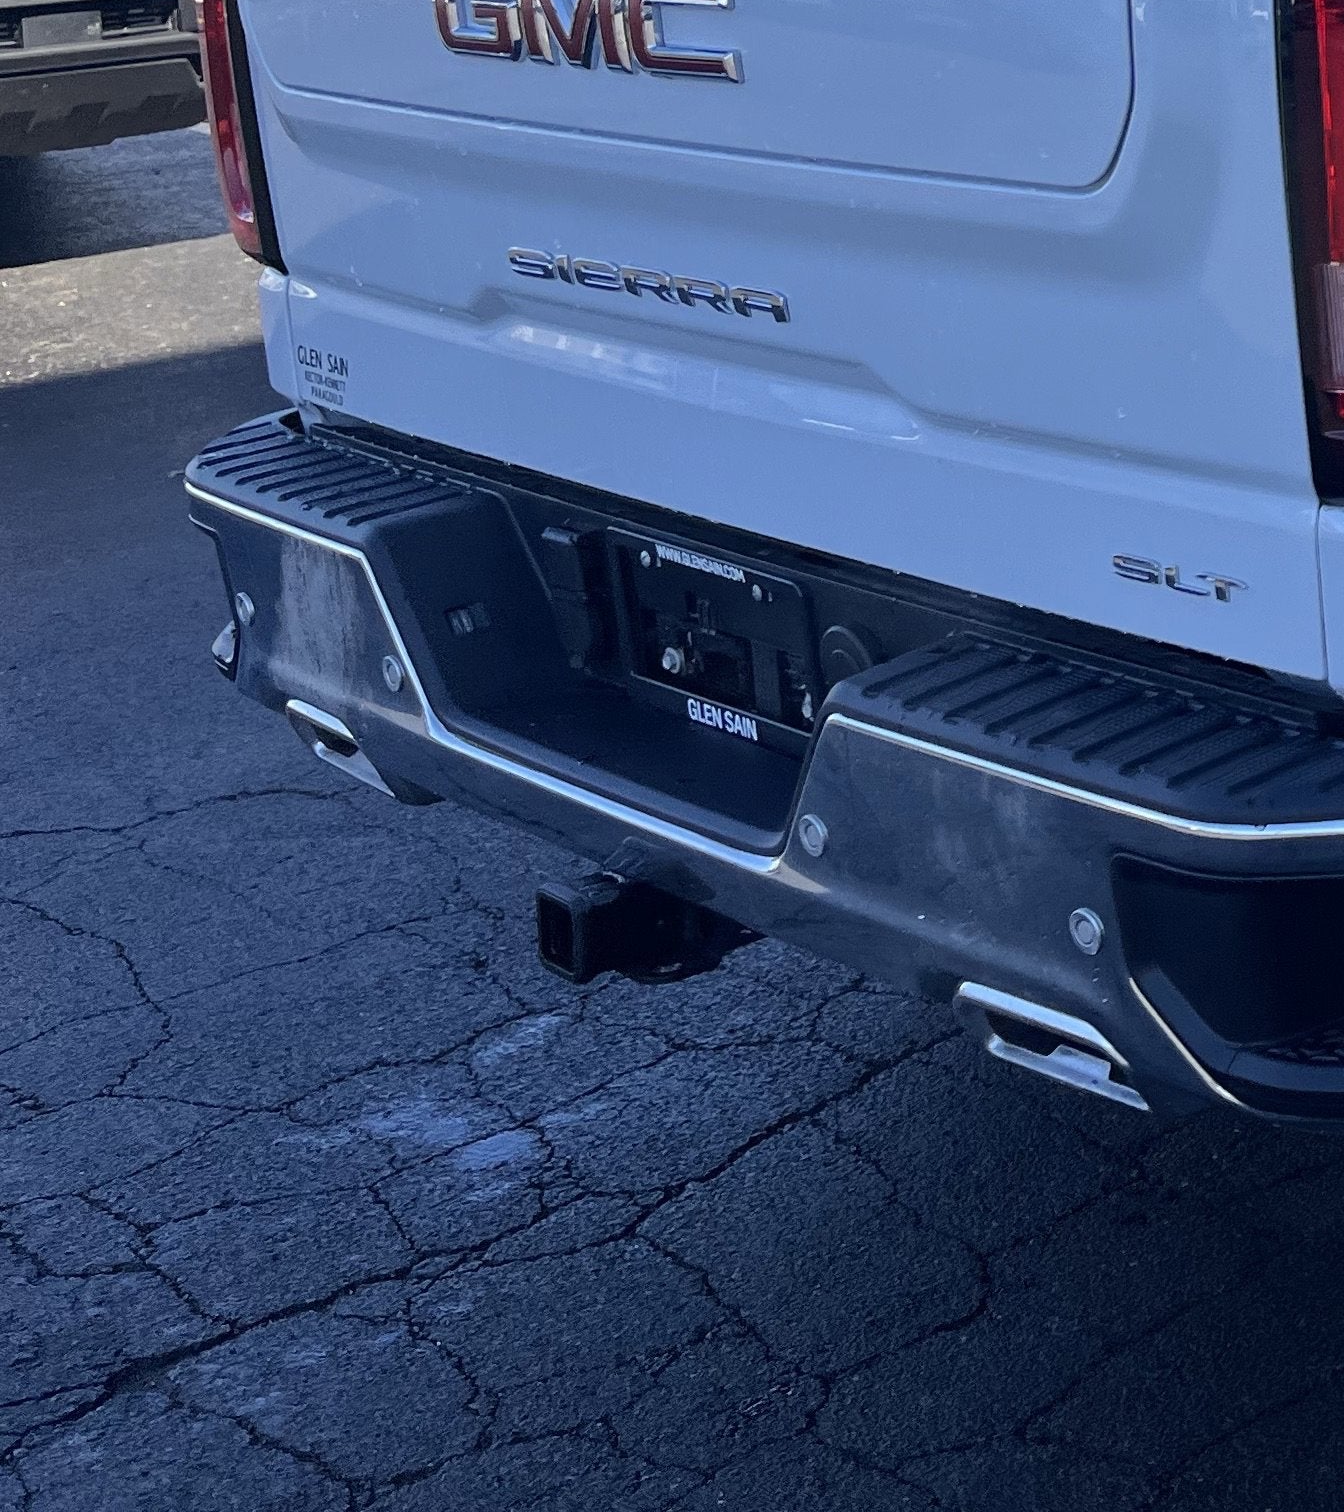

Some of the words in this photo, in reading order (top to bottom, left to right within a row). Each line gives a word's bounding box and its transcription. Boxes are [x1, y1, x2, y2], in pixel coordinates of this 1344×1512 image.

[507, 246, 790, 323] SIERRA
[297, 345, 322, 369] GLEN
[1113, 552, 1249, 602] SLT
[687, 698, 723, 729] GLEN
[724, 710, 758, 741] SAIN
